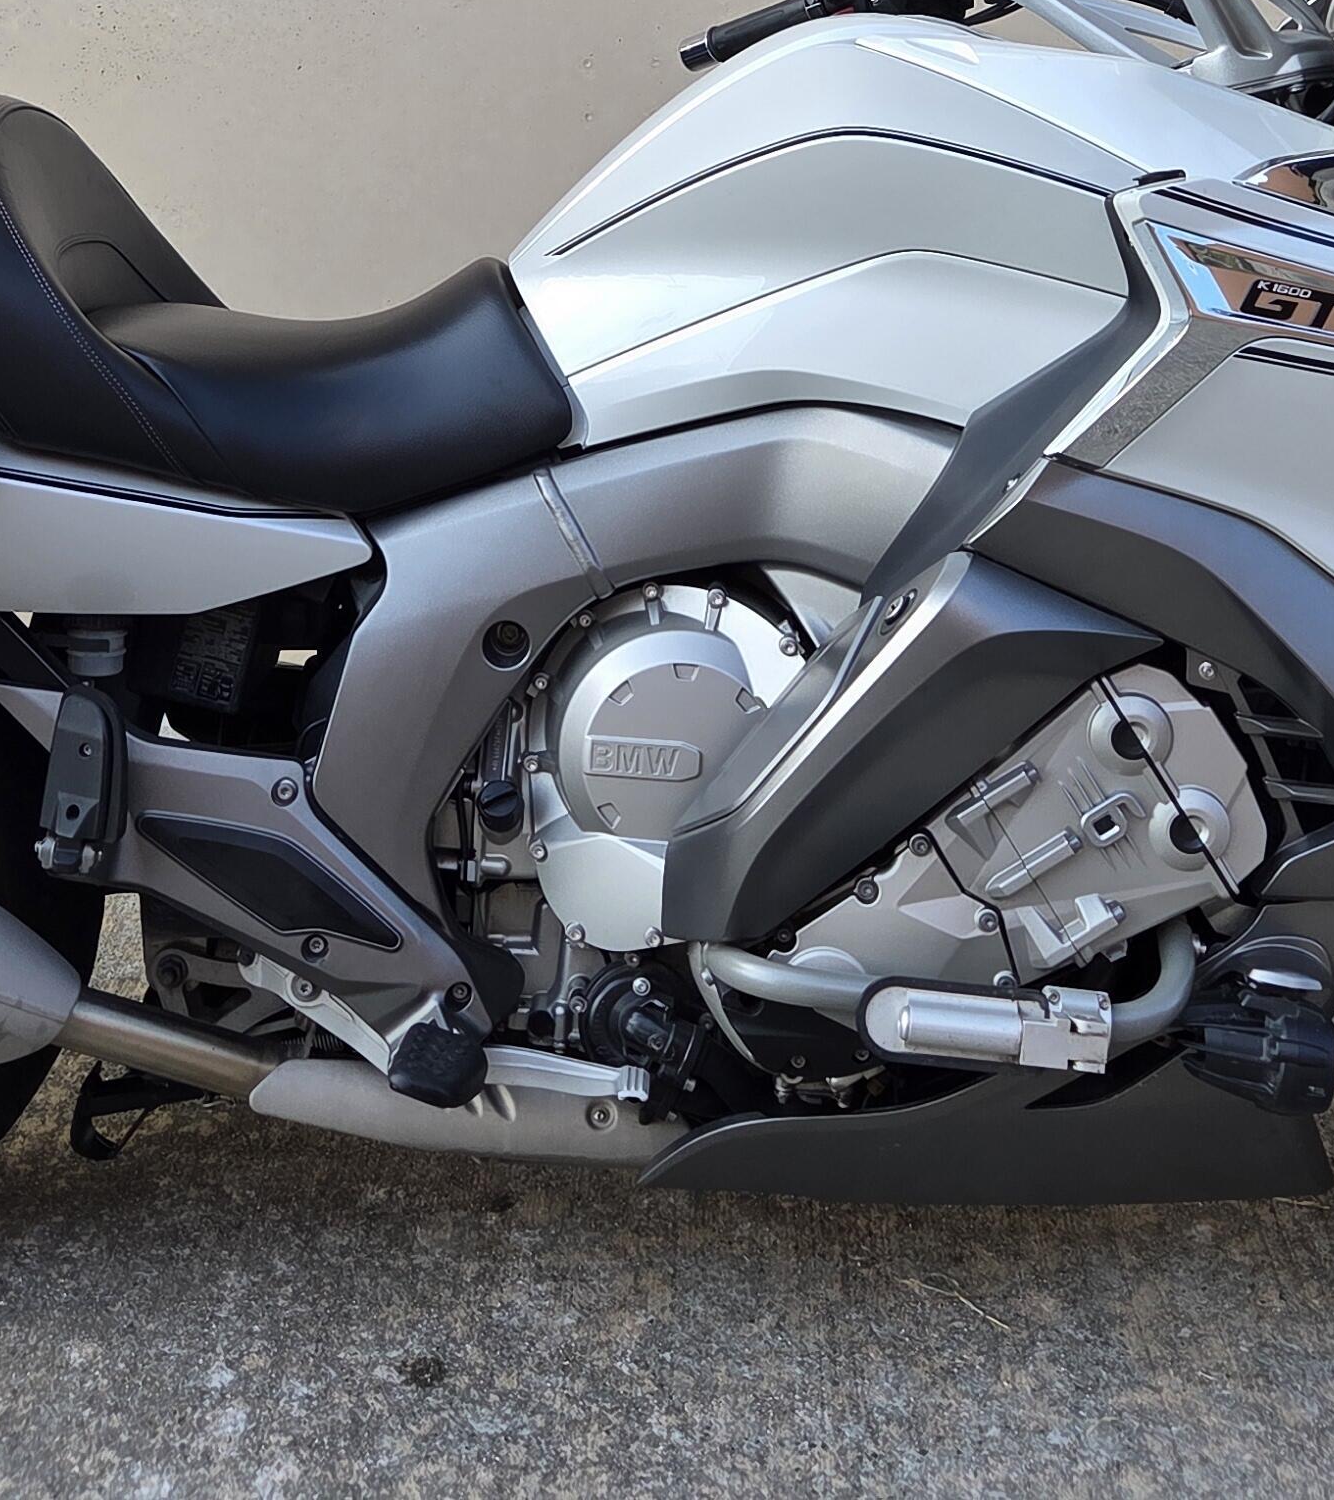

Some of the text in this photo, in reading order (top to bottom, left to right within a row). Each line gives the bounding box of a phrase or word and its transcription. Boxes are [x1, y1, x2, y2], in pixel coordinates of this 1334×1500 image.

[1257, 279, 1312, 299] K 1600
[590, 743, 681, 777] BMW
